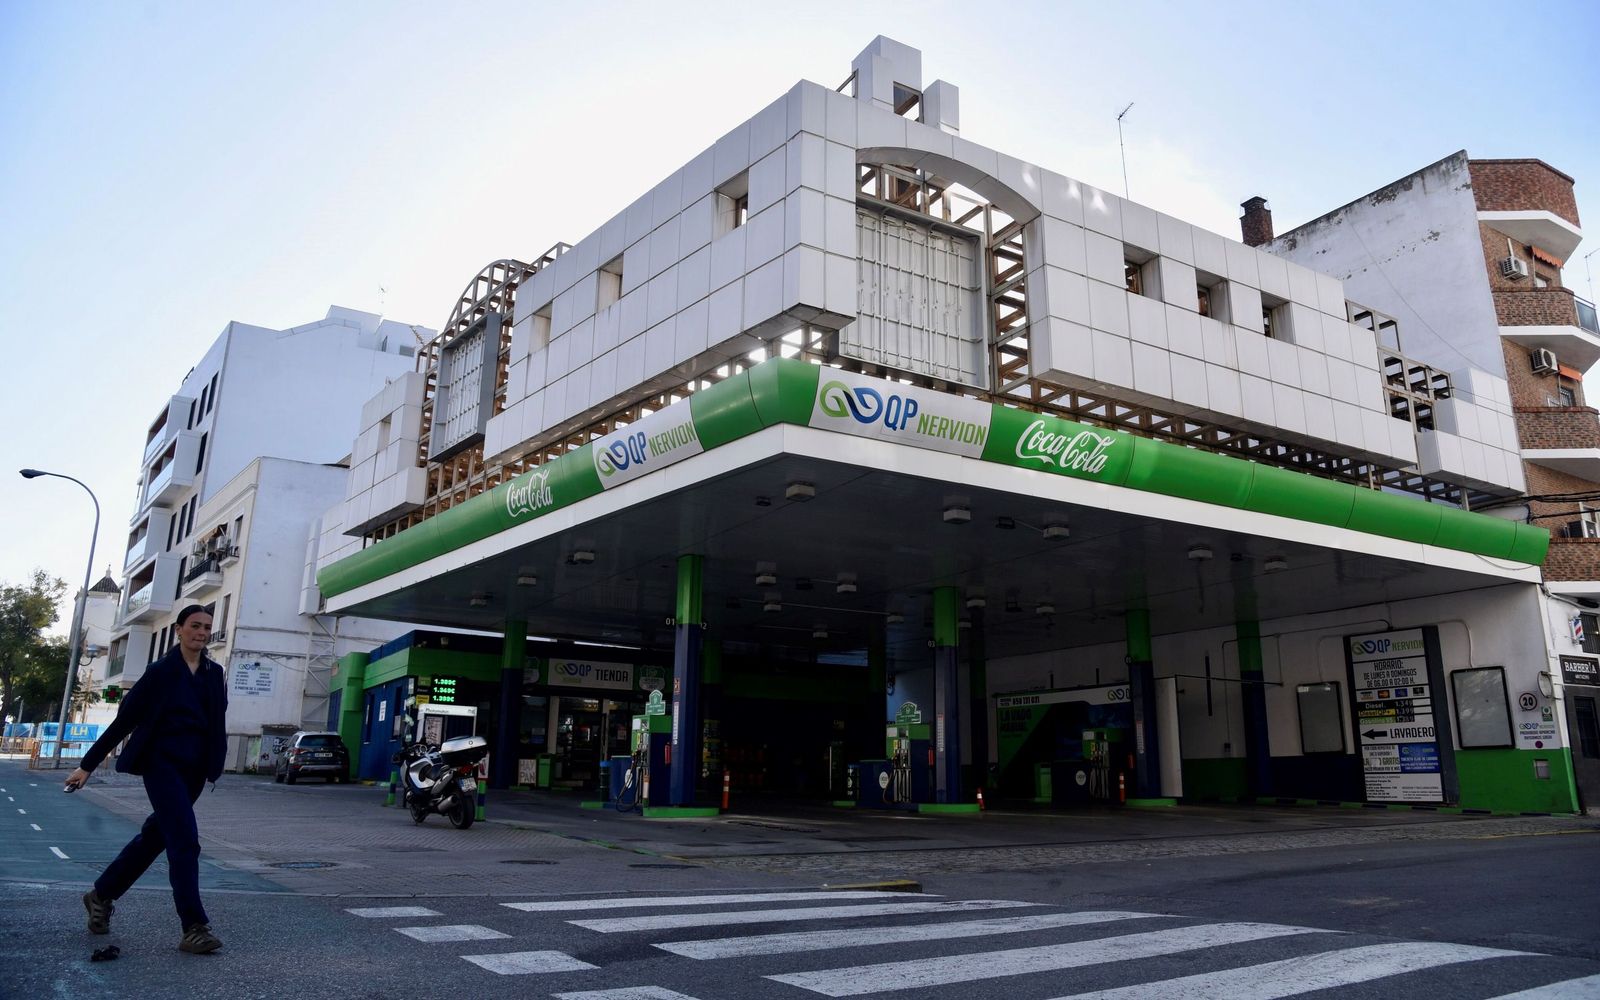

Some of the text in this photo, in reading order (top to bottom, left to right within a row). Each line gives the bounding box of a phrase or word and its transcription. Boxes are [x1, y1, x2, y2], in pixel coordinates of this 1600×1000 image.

[884, 394, 987, 447] QP NERVION
[628, 421, 697, 465] QP NERVION
[1015, 420, 1117, 475] Coca-Cola
[506, 469, 553, 518] Coca-Cola
[1377, 638, 1425, 654] QP NERVION
[579, 664, 592, 677] QP
[595, 668, 628, 682] TIENDA
[1370, 671, 1386, 680] LUNES
[1391, 668, 1417, 678] DOMINGOS
[1374, 660, 1404, 672] HORARIO:
[1522, 696, 1534, 707] 20
[1389, 727, 1434, 739] LAVADERO
